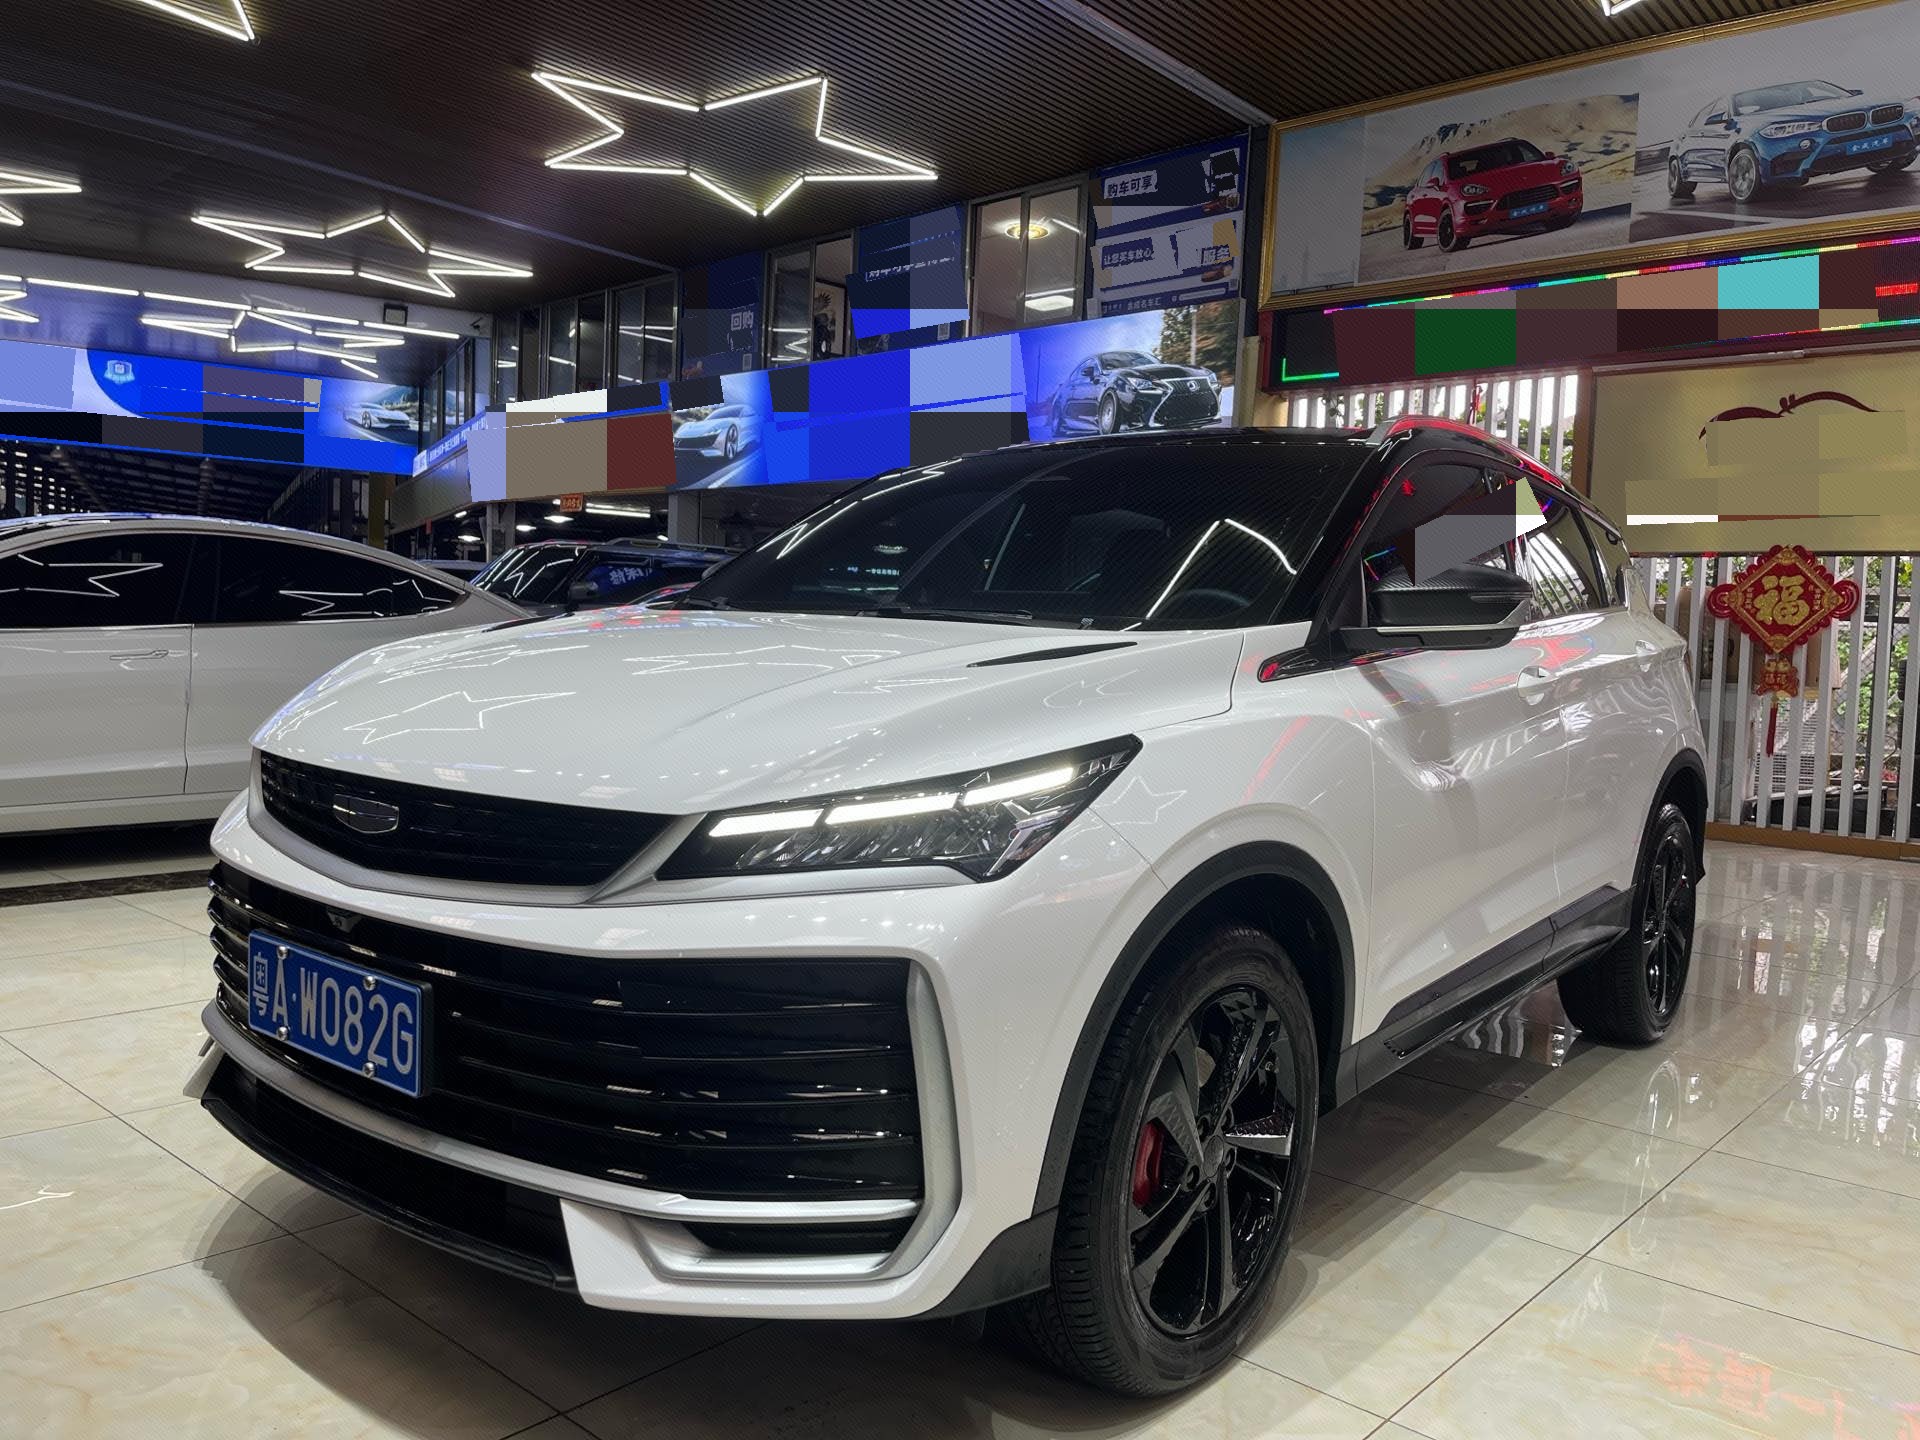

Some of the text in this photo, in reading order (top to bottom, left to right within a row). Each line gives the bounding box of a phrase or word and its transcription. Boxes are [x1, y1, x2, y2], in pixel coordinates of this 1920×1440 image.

[1107, 174, 1153, 197] 购车可享
[1753, 575, 1810, 626] 福
